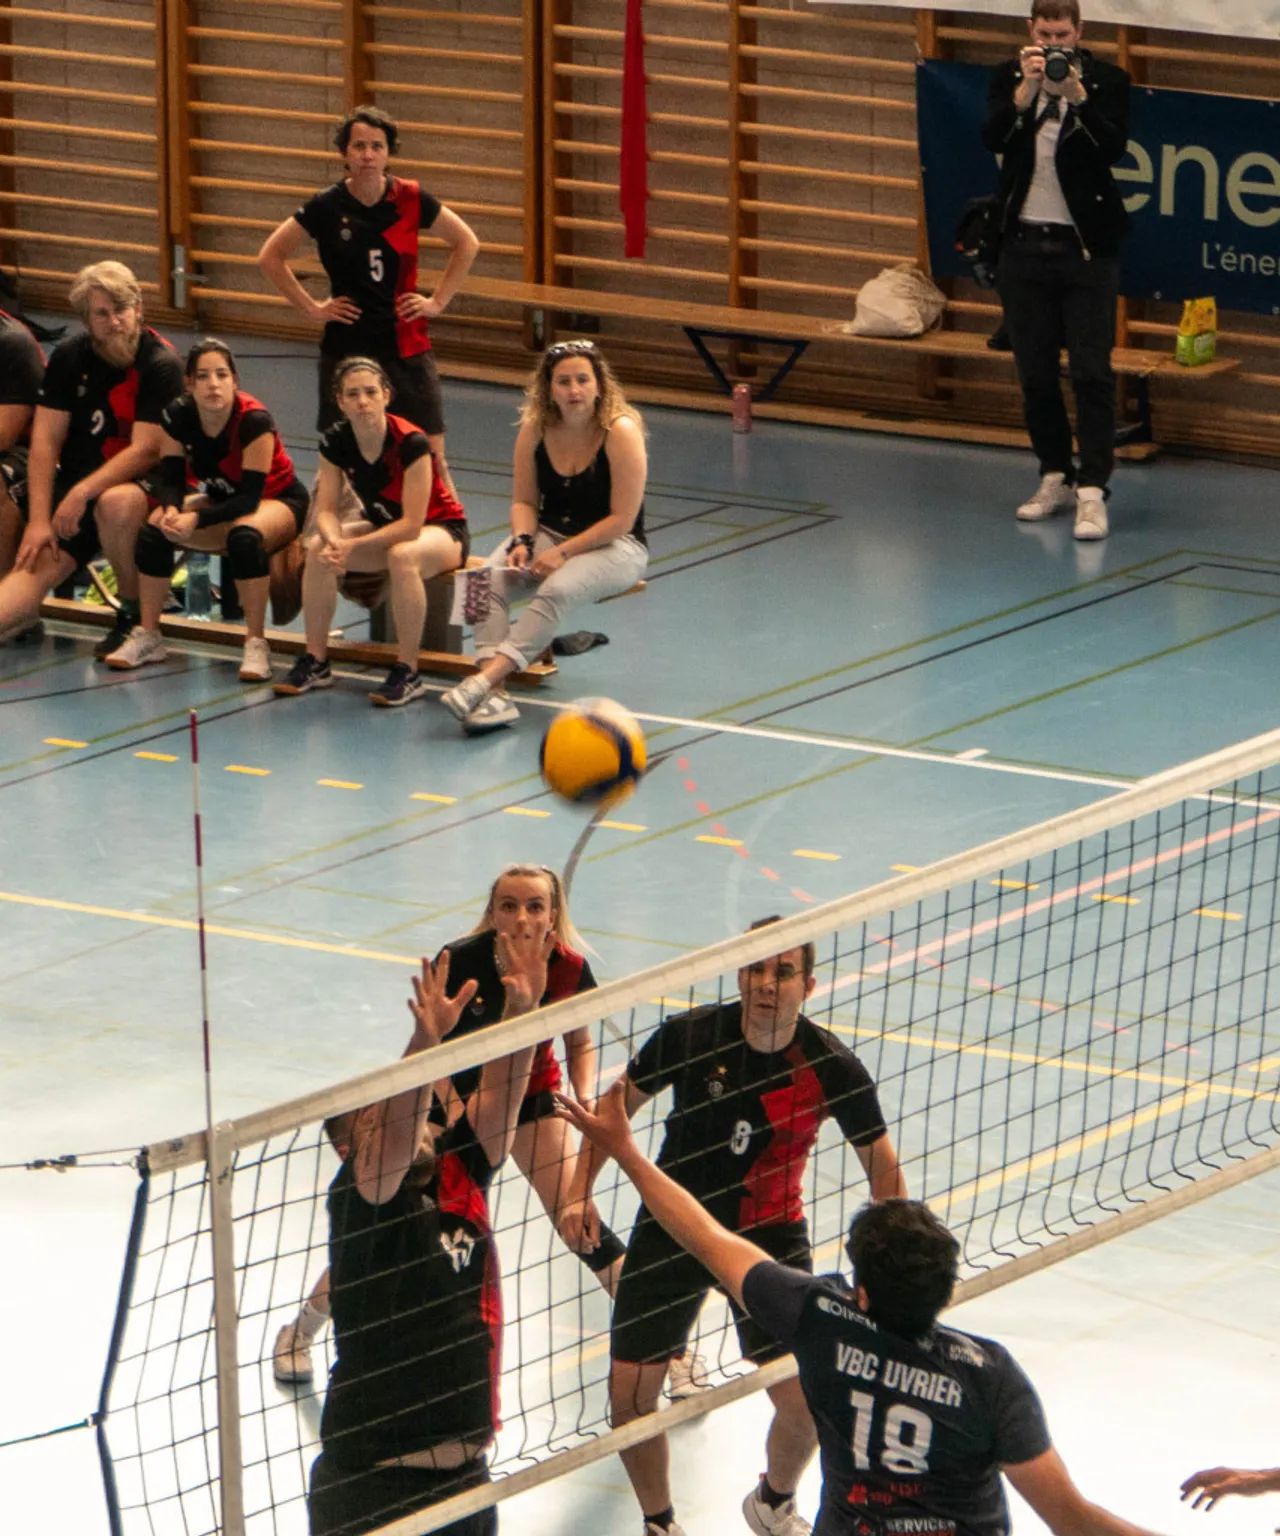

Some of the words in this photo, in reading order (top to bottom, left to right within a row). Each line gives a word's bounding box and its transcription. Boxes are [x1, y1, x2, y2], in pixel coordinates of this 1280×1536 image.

[368, 248, 385, 282] 5
[835, 1342, 880, 1381] VBC
[882, 1358, 962, 1407] UVRIER
[850, 1389, 933, 1475] 18
